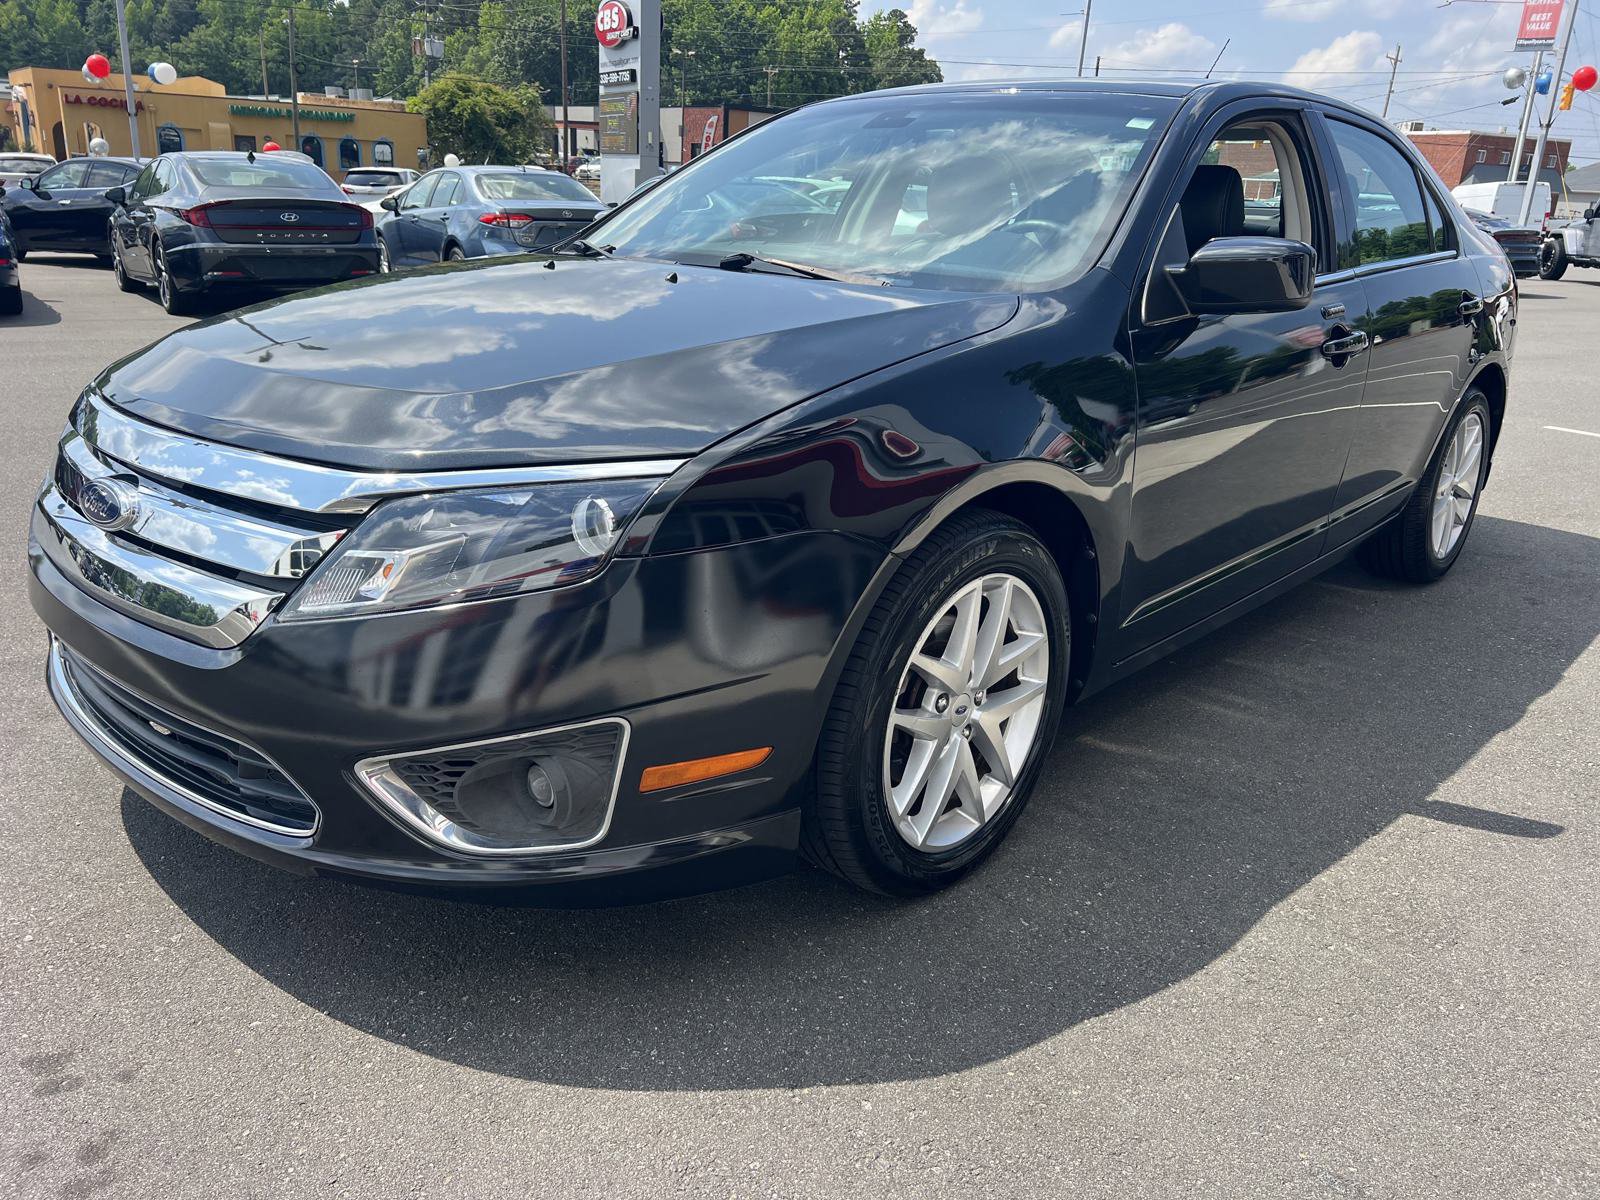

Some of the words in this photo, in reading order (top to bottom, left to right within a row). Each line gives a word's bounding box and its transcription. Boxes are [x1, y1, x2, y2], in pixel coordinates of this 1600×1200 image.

[597, 6, 620, 31] CBS
[1530, 12, 1552, 21] BEST
[1526, 21, 1552, 30] VALUE
[64, 93, 82, 105] LA
